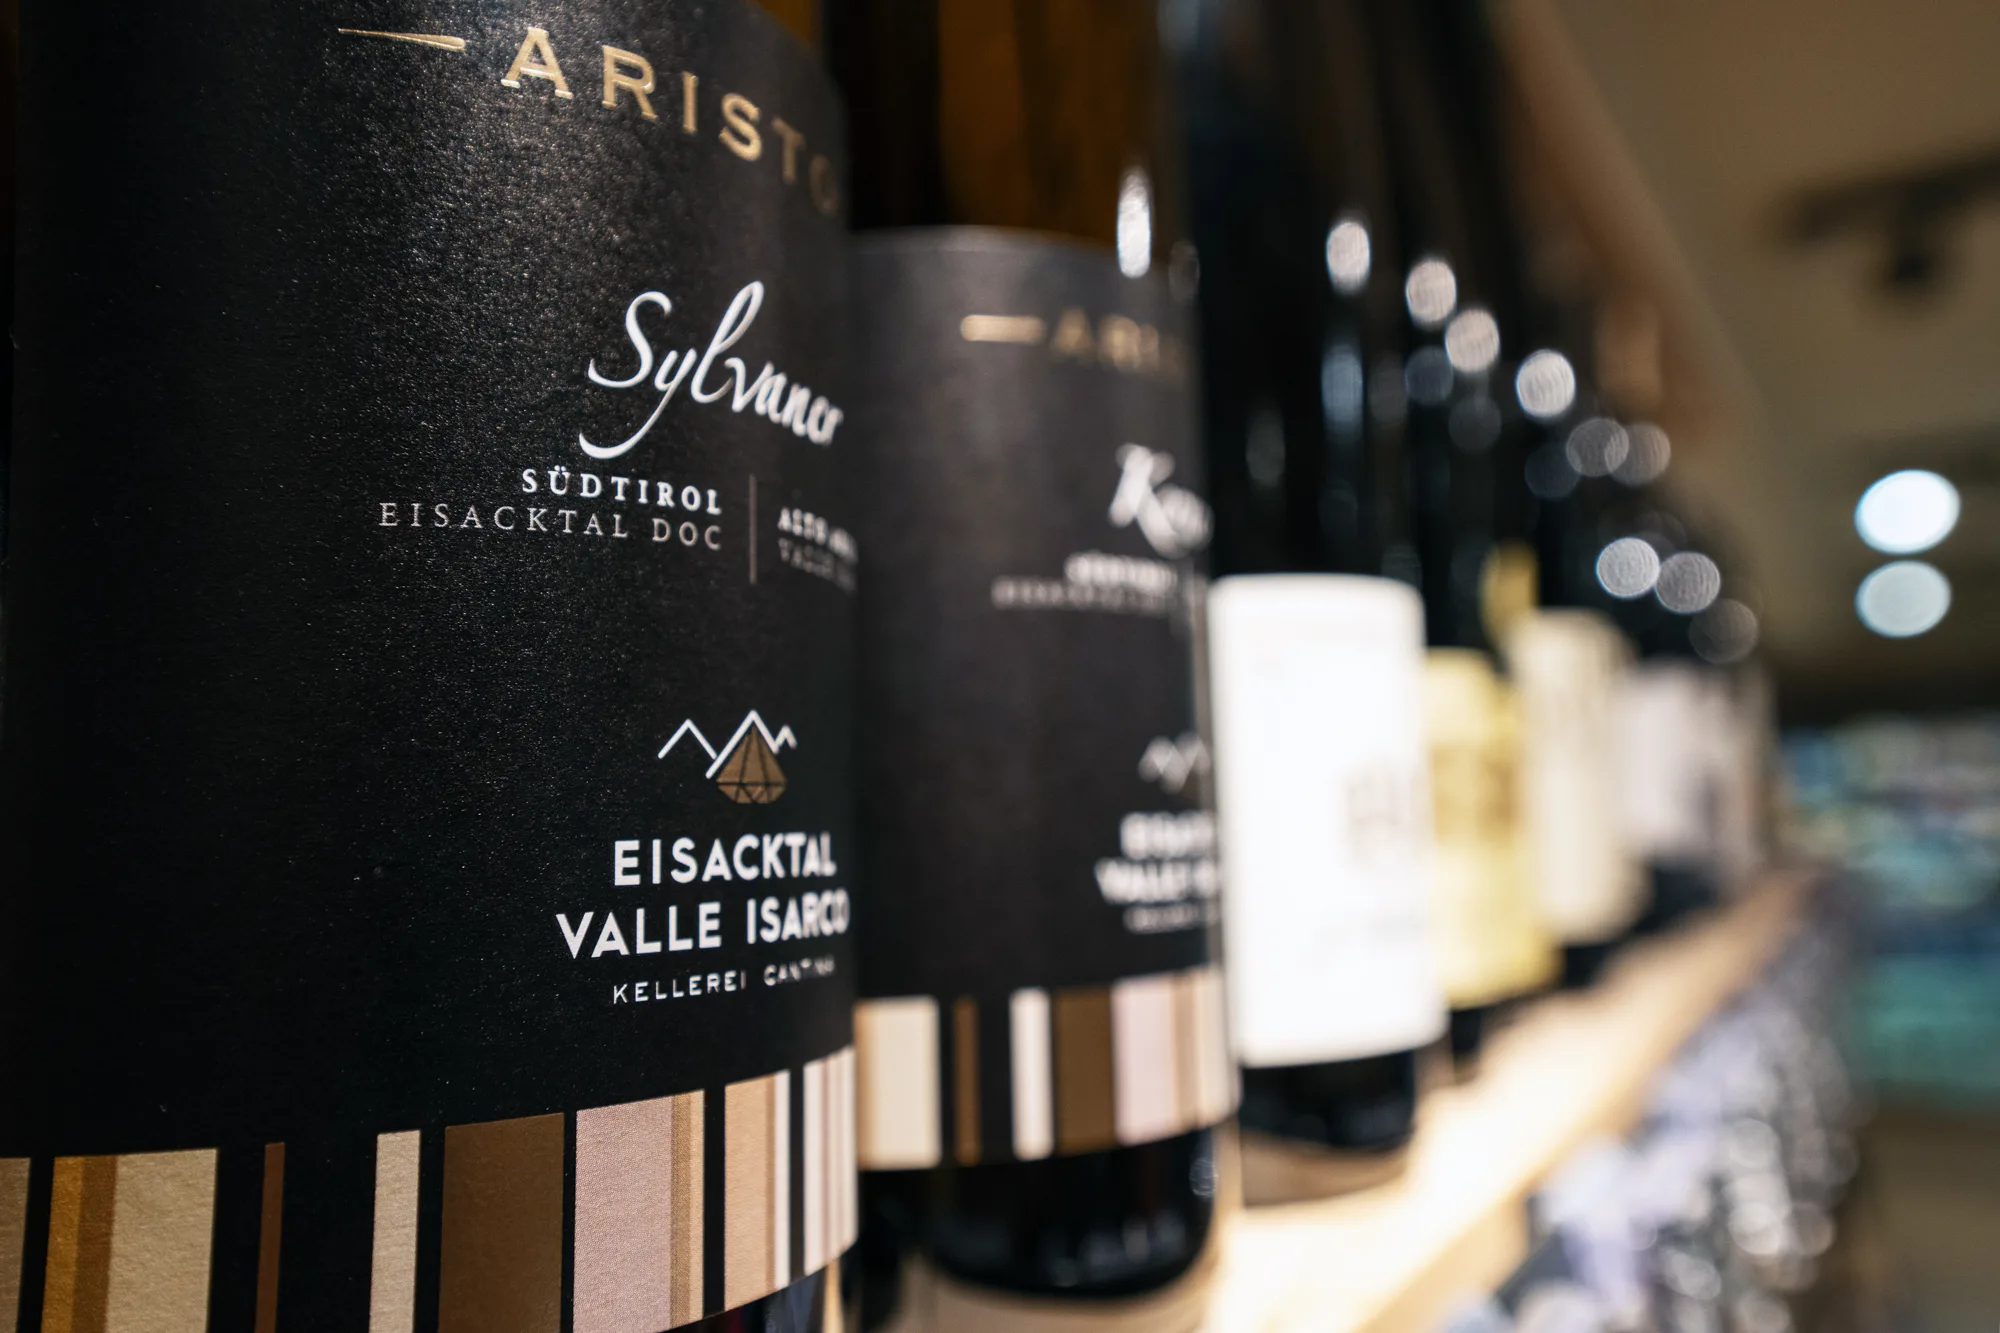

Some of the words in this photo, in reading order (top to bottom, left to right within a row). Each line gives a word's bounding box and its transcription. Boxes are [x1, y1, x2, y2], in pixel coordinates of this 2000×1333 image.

[522, 465, 722, 515] SÜDTIROL
[379, 502, 629, 538] EISACKTAL
[652, 518, 722, 551] DOC
[614, 832, 837, 886] EISACKTAL
[555, 902, 722, 960] VALLE
[746, 888, 850, 945] ISARCO
[612, 969, 747, 1005] KELLEREI
